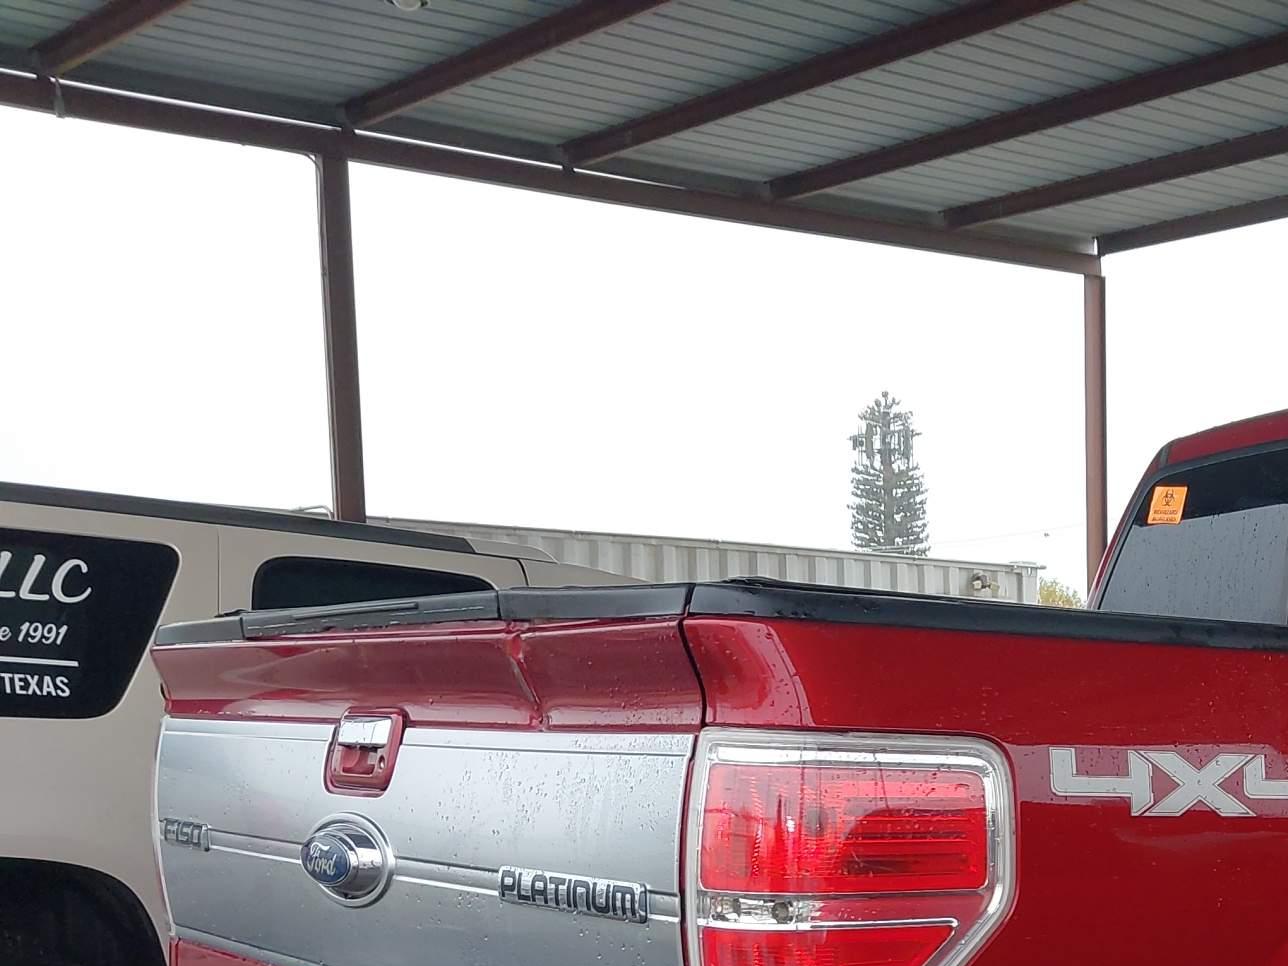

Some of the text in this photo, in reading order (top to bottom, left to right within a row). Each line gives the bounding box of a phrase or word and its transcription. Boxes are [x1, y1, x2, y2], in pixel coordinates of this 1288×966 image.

[0, 551, 92, 604] LLC
[18, 621, 68, 645] 1991
[0, 672, 71, 697] TEXAS
[306, 841, 337, 876] Ford
[500, 869, 637, 919] PLATINUM
